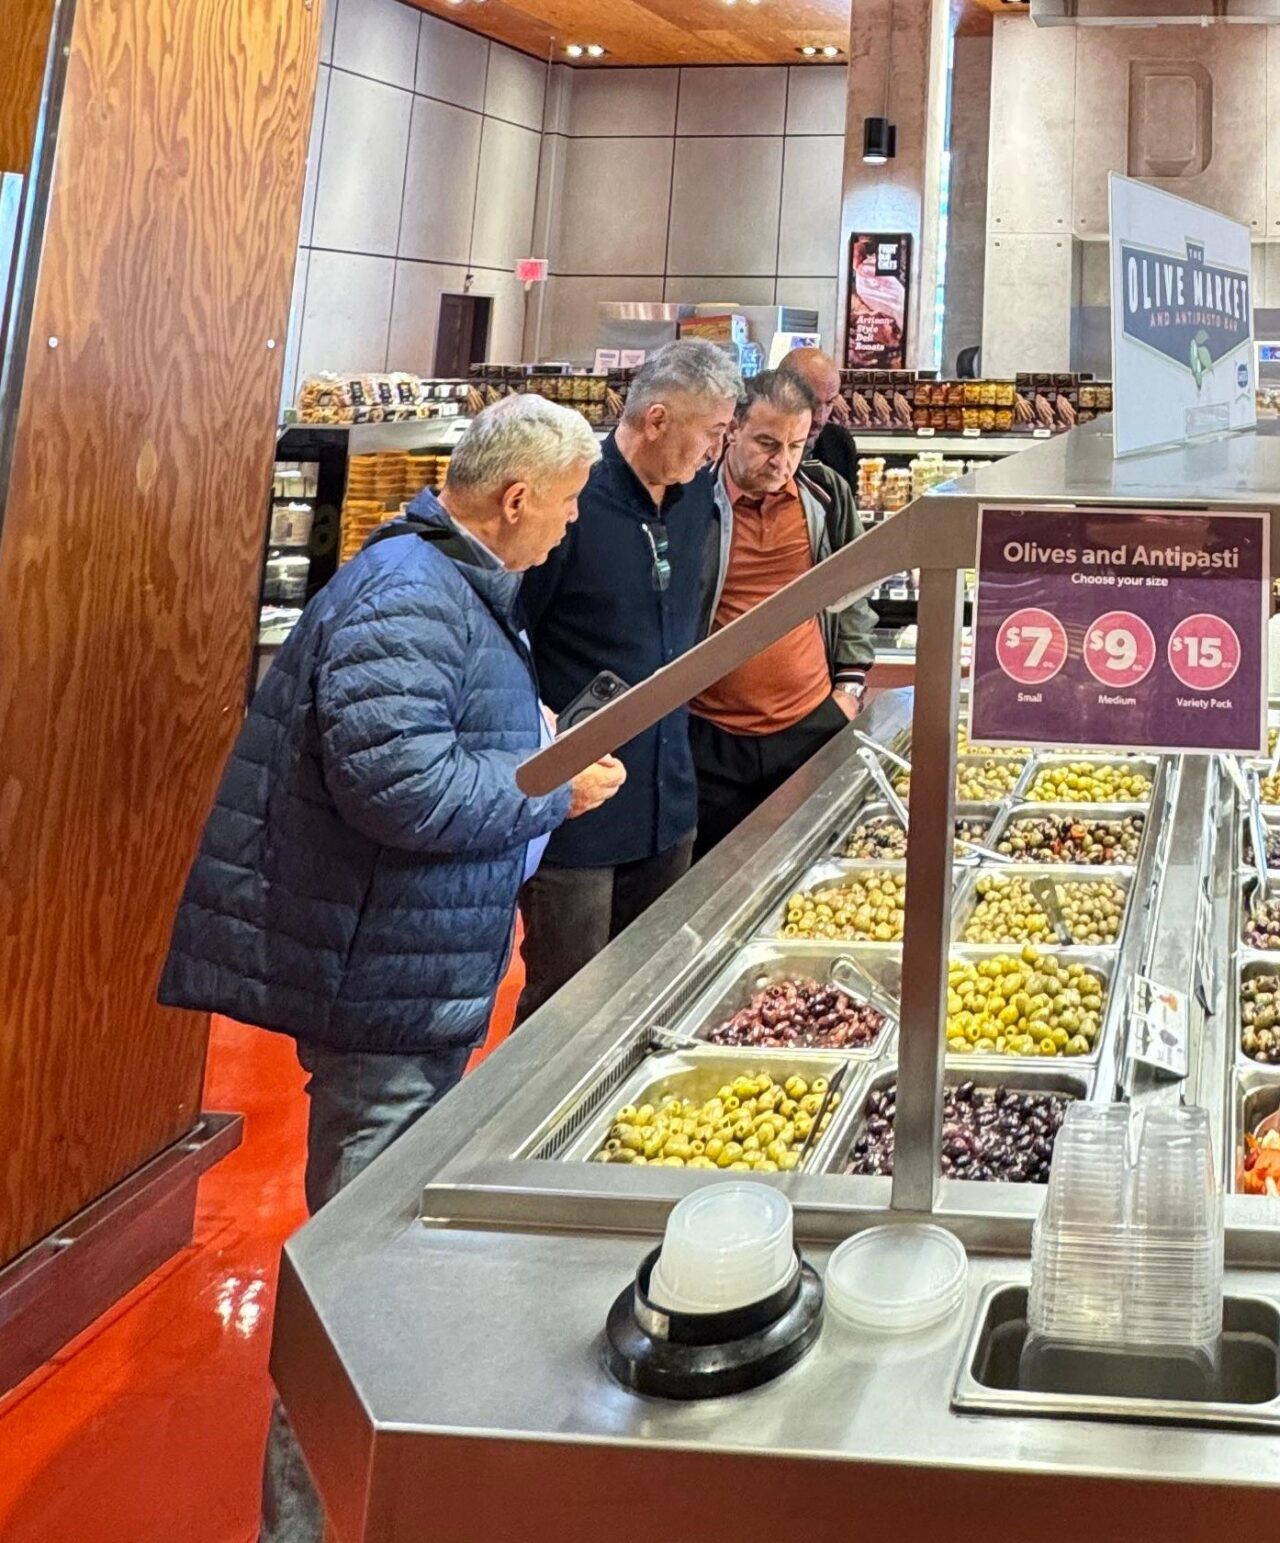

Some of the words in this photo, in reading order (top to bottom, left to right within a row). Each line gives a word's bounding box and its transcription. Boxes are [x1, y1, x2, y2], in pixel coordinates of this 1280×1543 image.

[1128, 257, 1185, 313] OLIVE
[1193, 270, 1247, 322] MARKET
[1151, 311, 1170, 328] AND
[1175, 311, 1220, 328] ANTIPASTO
[1224, 317, 1238, 332] BAR
[855, 333, 874, 342] Deli
[1003, 542, 1077, 564] Olives
[1082, 545, 1126, 565] and
[1131, 545, 1239, 571] Antipasti
[1071, 572, 1115, 585] Choose
[1117, 576, 1143, 587] your
[1145, 575, 1169, 587] size
[1006, 626, 1053, 667] $7
[1089, 628, 1138, 671] $9
[1172, 636, 1223, 668] $15
[1017, 692, 1043, 702] Small
[1098, 694, 1136, 705] Medium
[1176, 697, 1209, 709] Variety
[1210, 698, 1233, 708] Pack
